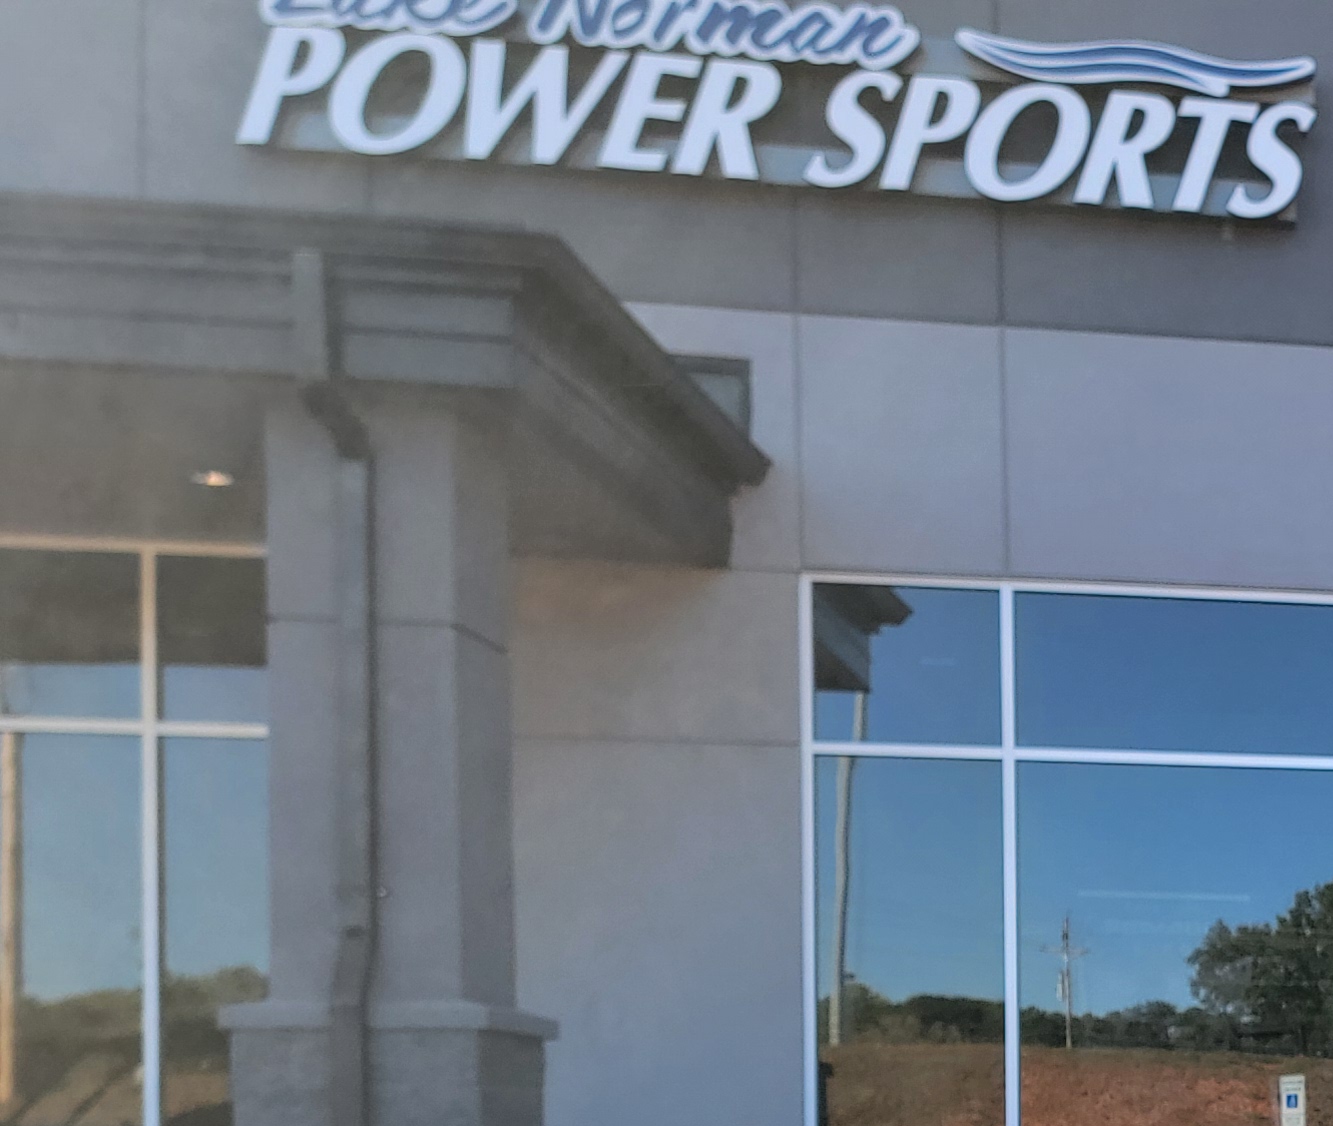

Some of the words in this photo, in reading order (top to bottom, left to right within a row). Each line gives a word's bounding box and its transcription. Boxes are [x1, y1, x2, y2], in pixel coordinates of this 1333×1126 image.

[527, 0, 921, 70] Norman
[235, 27, 783, 181] POWER
[801, 69, 1318, 220] SPORTS
